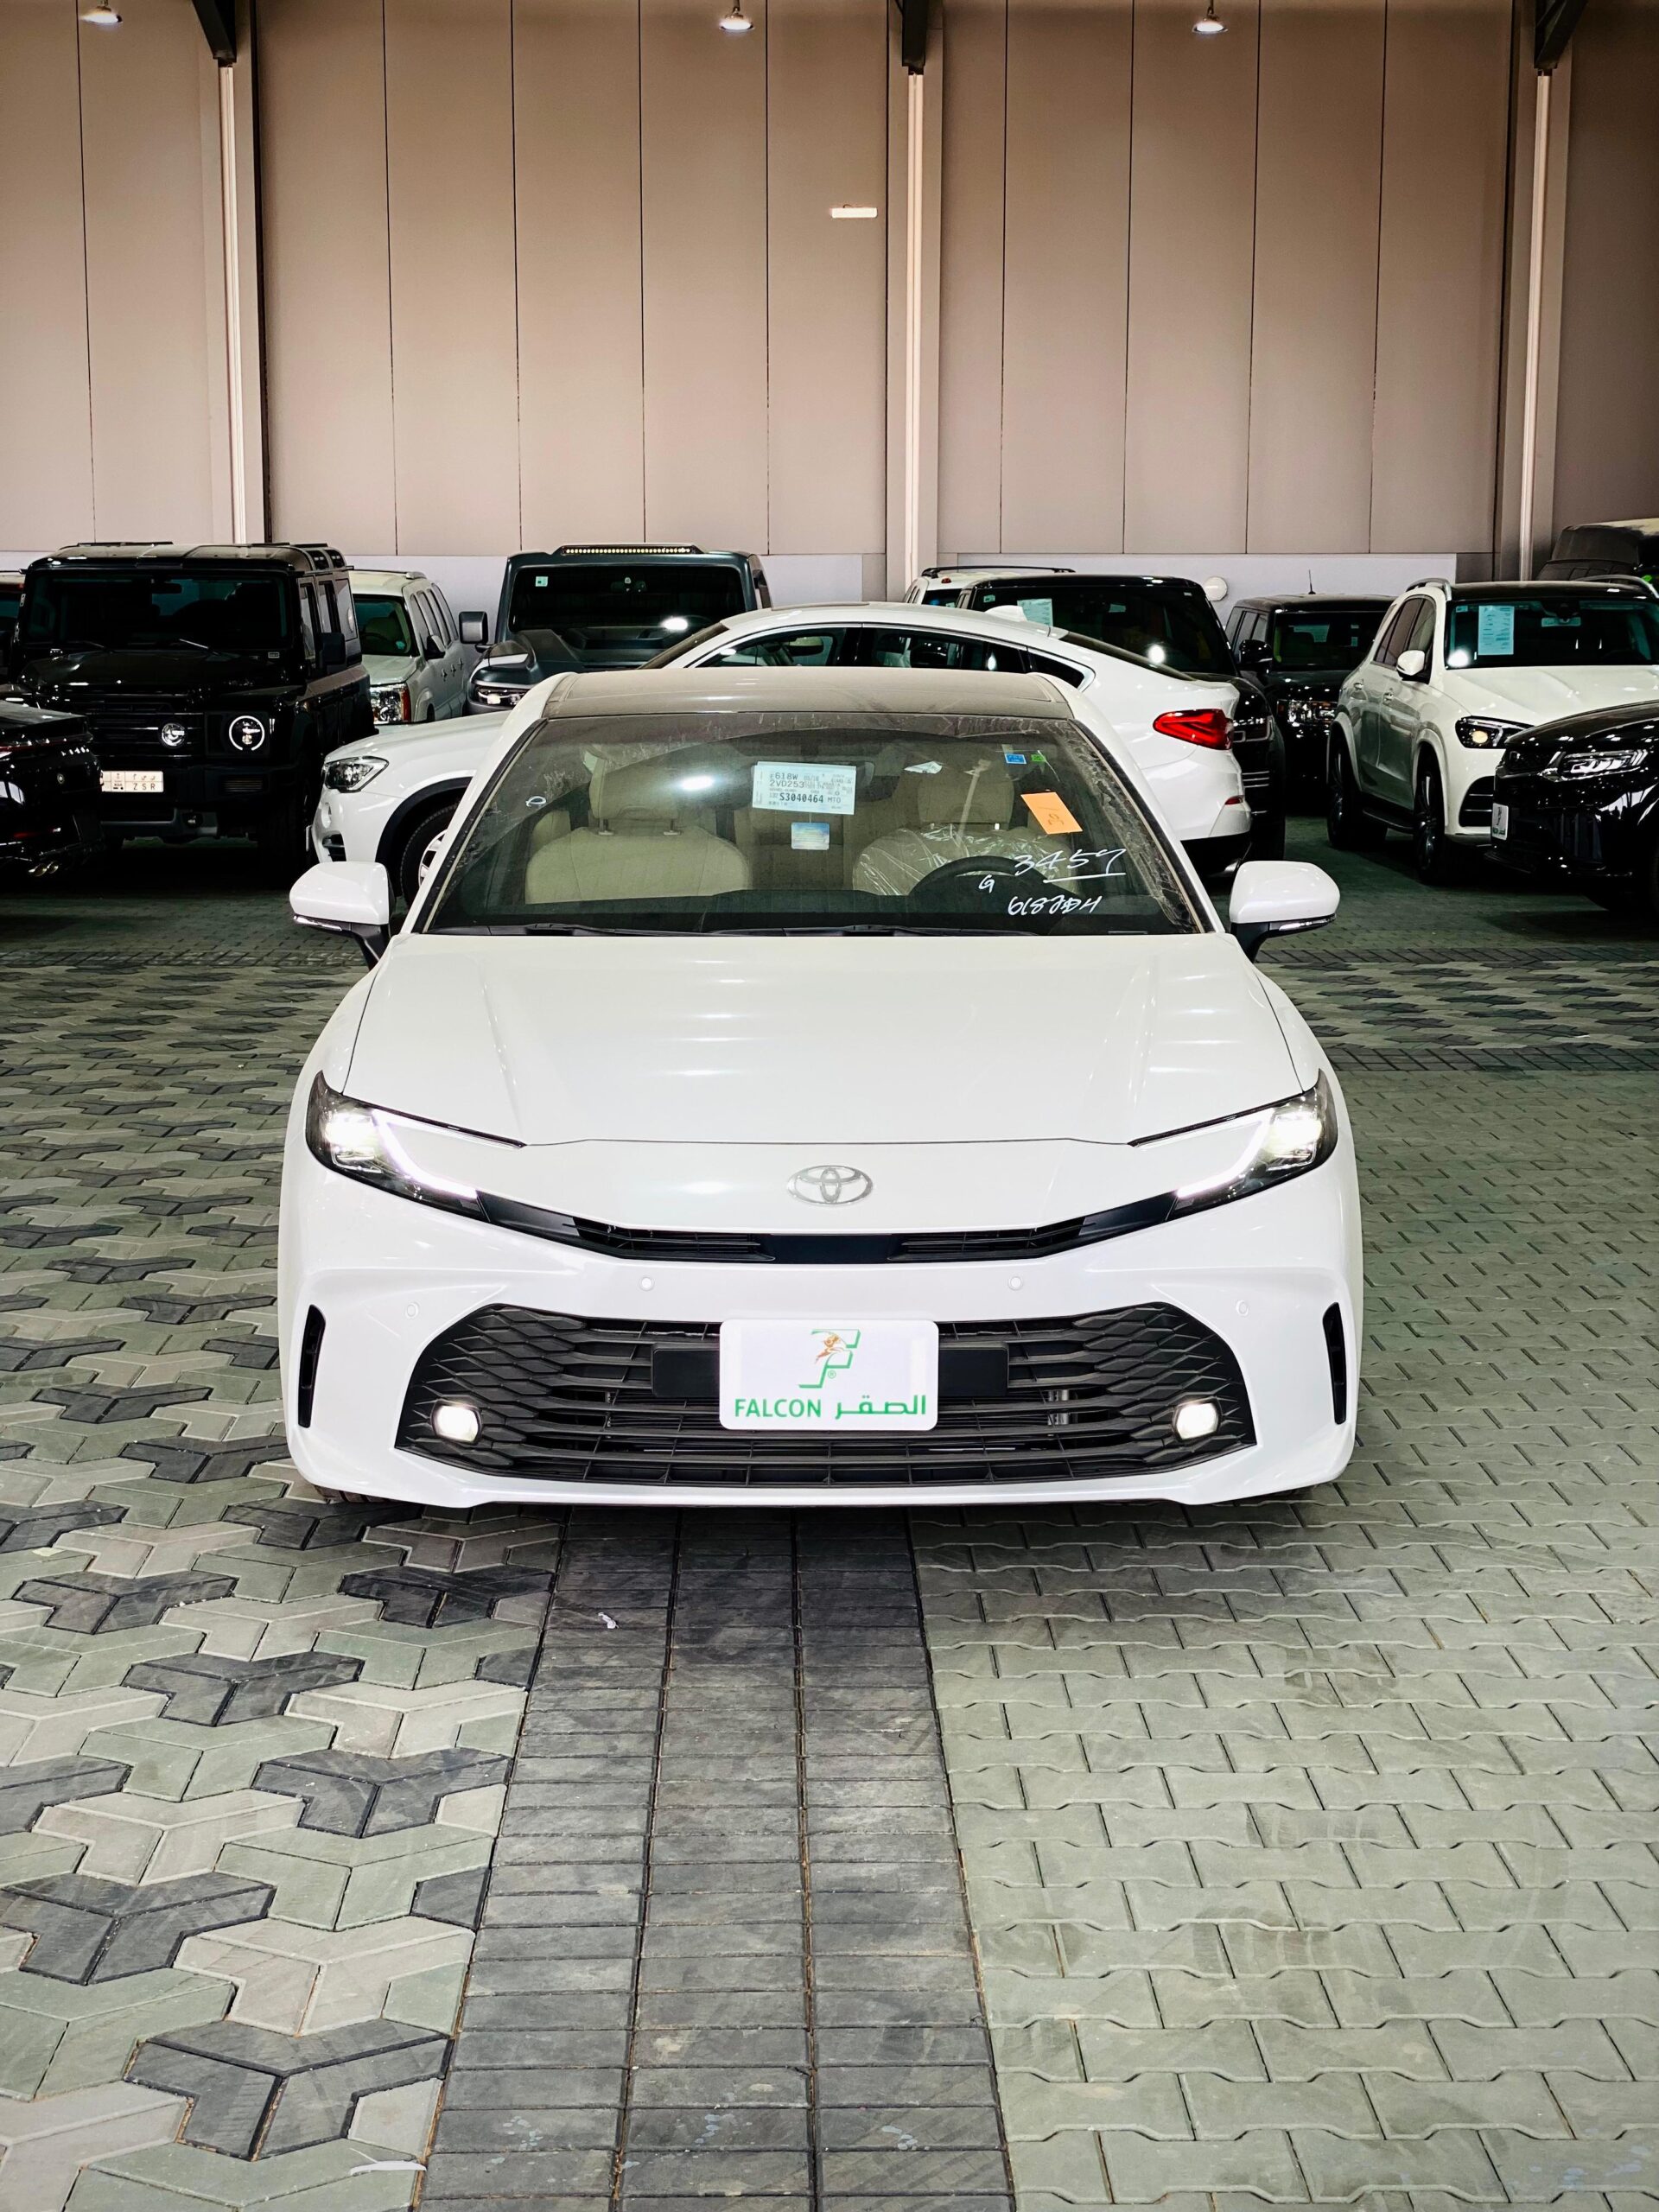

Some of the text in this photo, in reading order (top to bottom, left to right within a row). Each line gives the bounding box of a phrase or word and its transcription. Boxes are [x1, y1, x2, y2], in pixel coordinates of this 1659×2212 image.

[779, 792, 823, 804] S3040464
[734, 1398, 821, 1418] FALCON
[835, 1395, 926, 1421] الصقر
